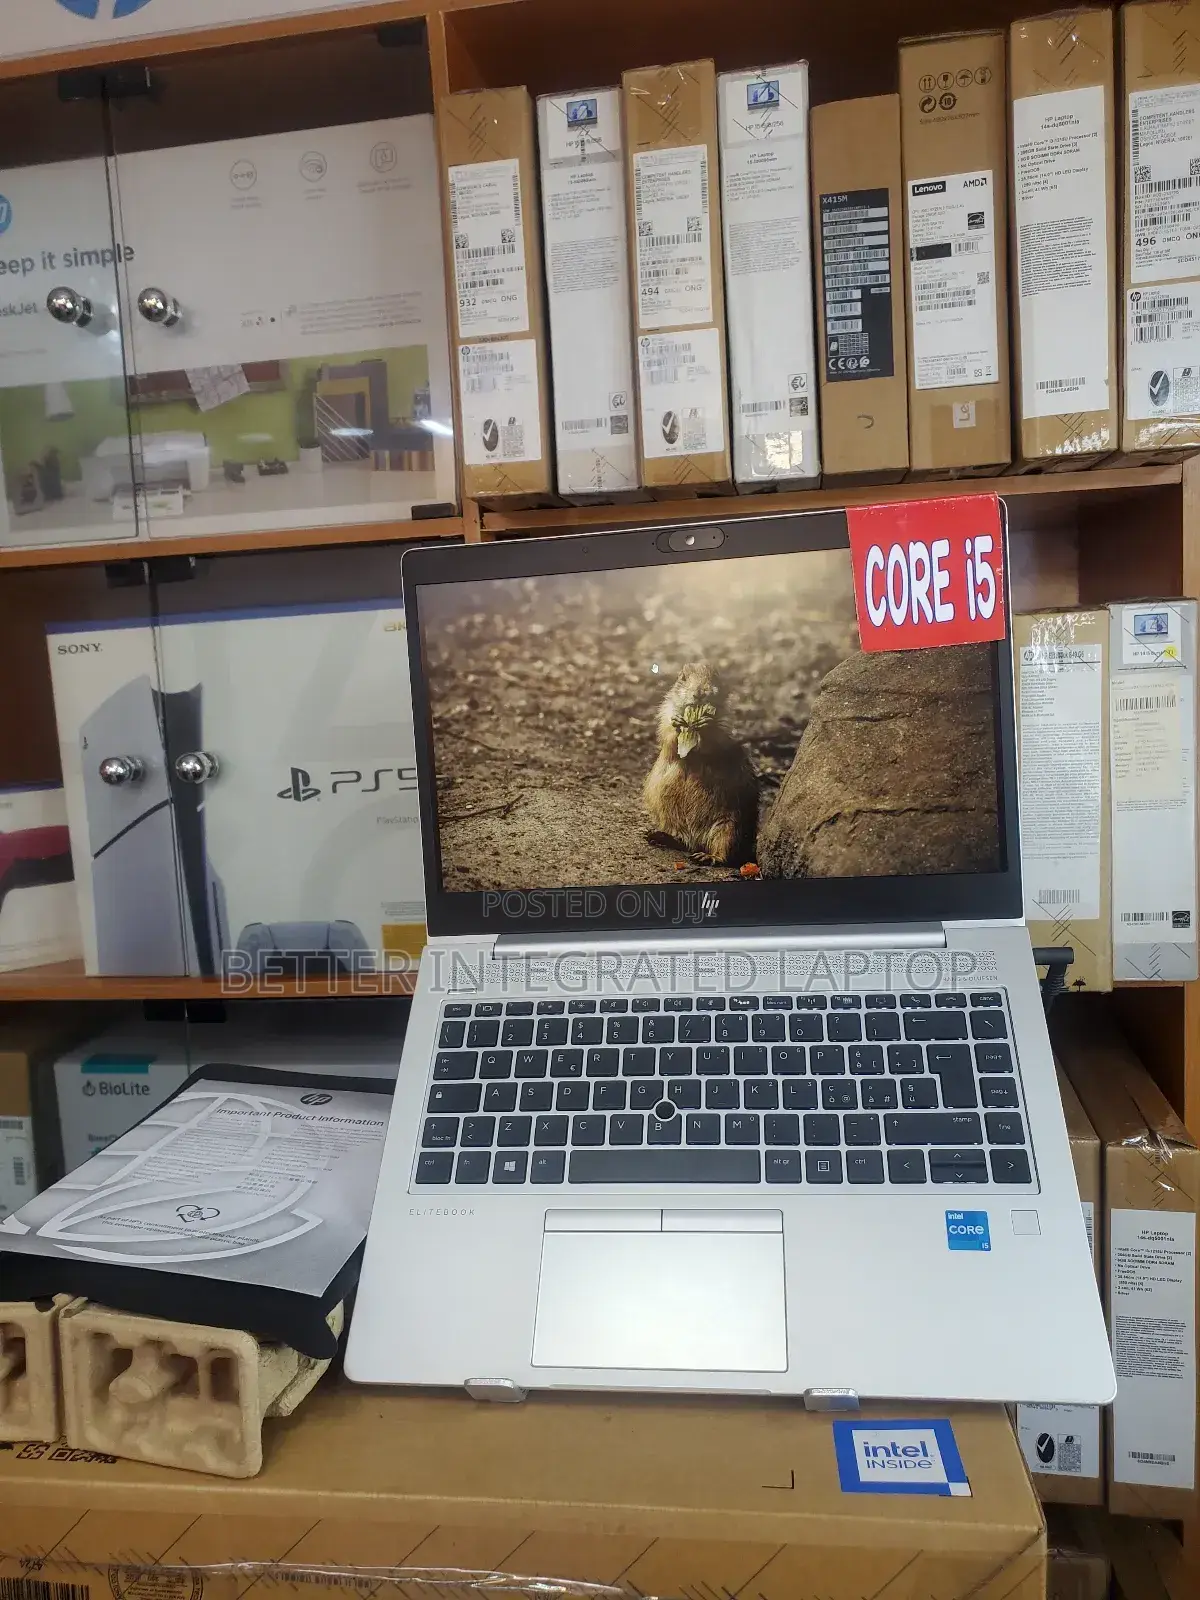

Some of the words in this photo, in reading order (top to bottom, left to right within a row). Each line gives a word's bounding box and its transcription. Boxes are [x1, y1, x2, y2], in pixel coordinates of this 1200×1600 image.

[914, 184, 943, 193] Lenovo
[963, 179, 980, 188] AMD
[822, 195, 848, 204] X415M
[1135, 237, 1156, 247] 496
[0, 257, 35, 277] eep
[41, 250, 56, 270] it
[62, 243, 134, 268] simple
[641, 287, 659, 296] 494
[459, 298, 476, 307] 932
[865, 539, 955, 627] CORE
[965, 534, 996, 621] i5
[57, 643, 101, 655] SONY
[487, 1056, 496, 1064] Q
[703, 1052, 711, 1060] U
[100, 1081, 150, 1096] BioLite
[492, 1089, 500, 1097] A
[528, 1088, 534, 1096] S
[564, 1087, 571, 1095] D
[638, 1086, 646, 1094] G
[674, 1086, 682, 1094] H
[751, 1086, 758, 1094] K
[300, 1093, 333, 1106] hp
[217, 1108, 271, 1117] Important
[273, 1111, 316, 1121] Product
[318, 1115, 384, 1127] Information
[505, 1122, 512, 1130] Z
[542, 1122, 549, 1130] X
[579, 1121, 587, 1130] C
[617, 1121, 625, 1129] V
[693, 1121, 701, 1129] N
[732, 1121, 741, 1129] M
[409, 1208, 476, 1216] ELITEBOOK
[947, 1212, 964, 1220] intel
[863, 1440, 929, 1458] intel
